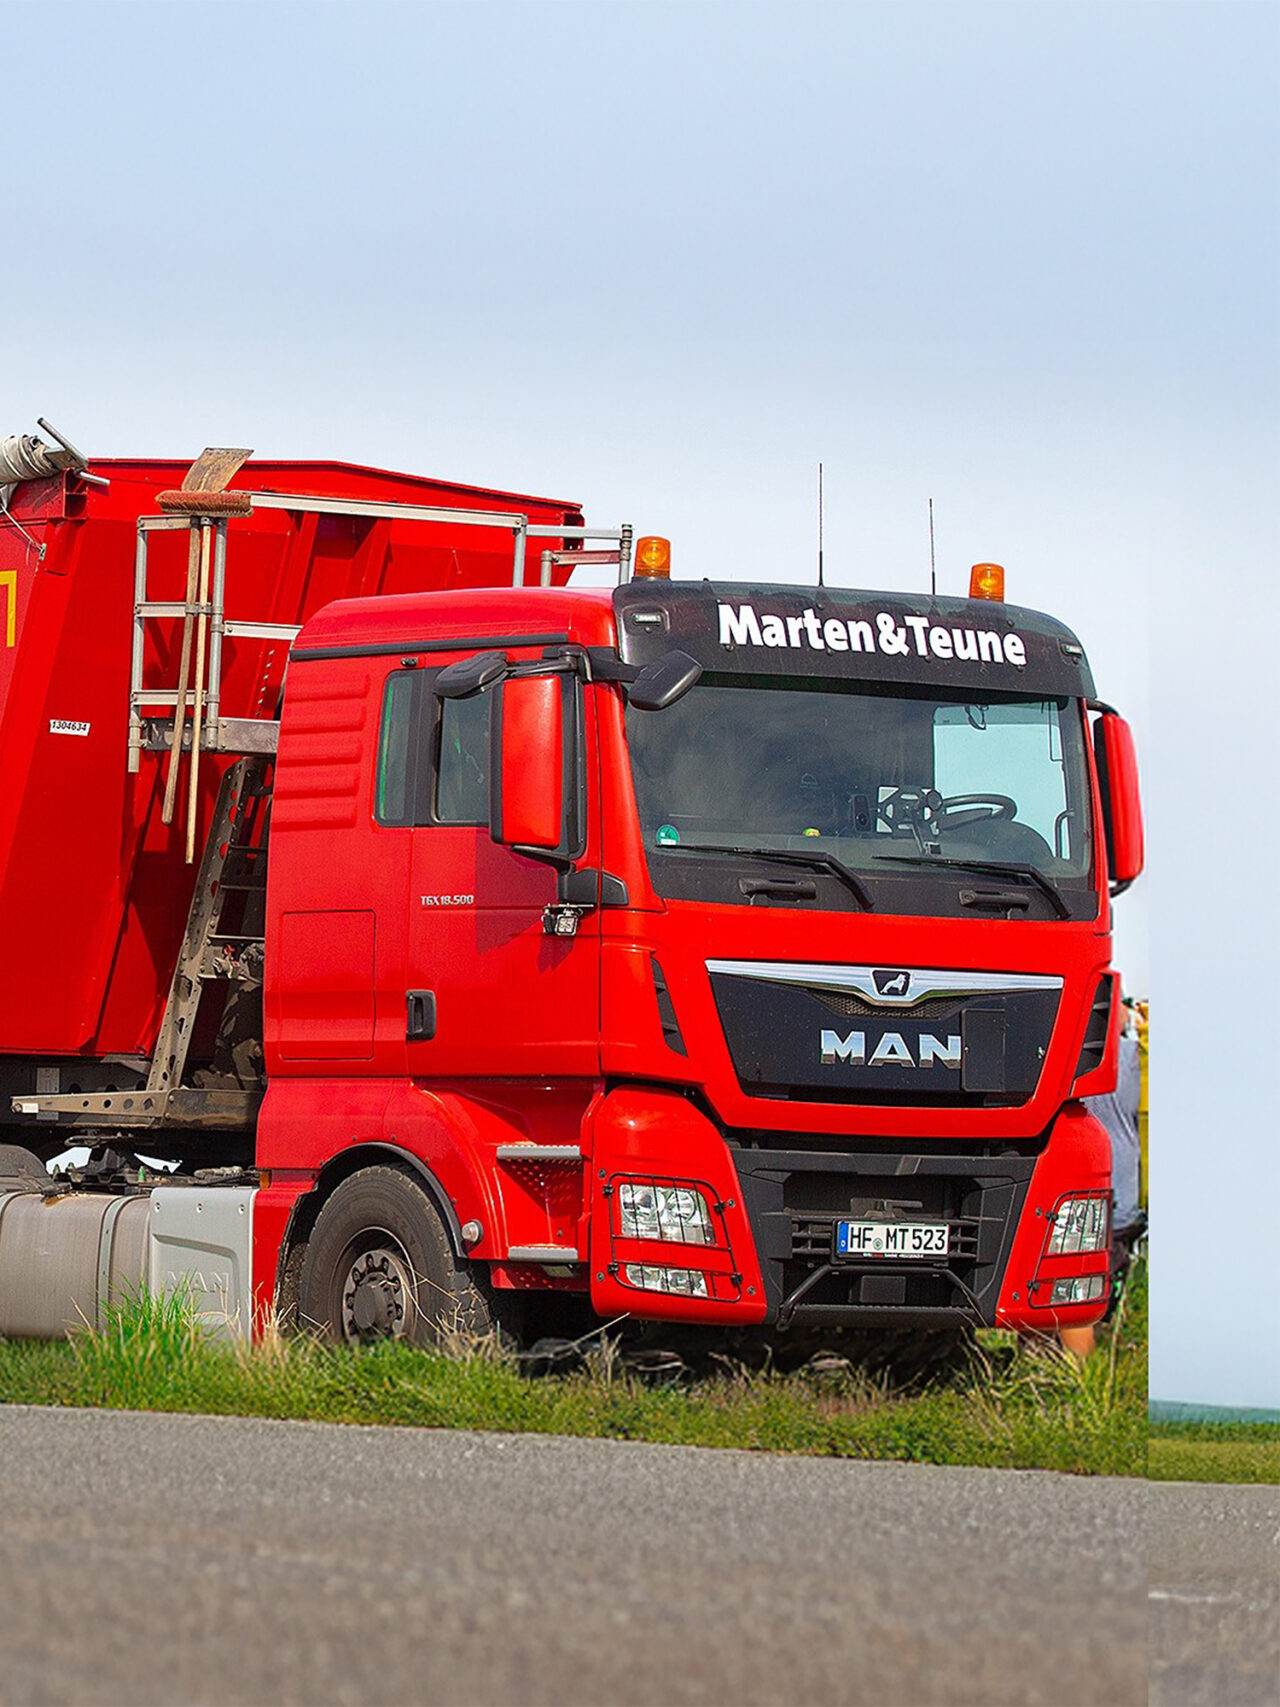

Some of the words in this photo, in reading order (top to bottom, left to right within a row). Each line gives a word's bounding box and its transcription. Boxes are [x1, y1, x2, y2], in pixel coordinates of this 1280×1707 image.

[717, 604, 1027, 667] Marten&Teune
[420, 895, 440, 906] TGX
[440, 894, 474, 906] 18.500
[820, 1029, 962, 1069] MAN
[850, 1226, 873, 1248] HF
[912, 1229, 946, 1250] 523
